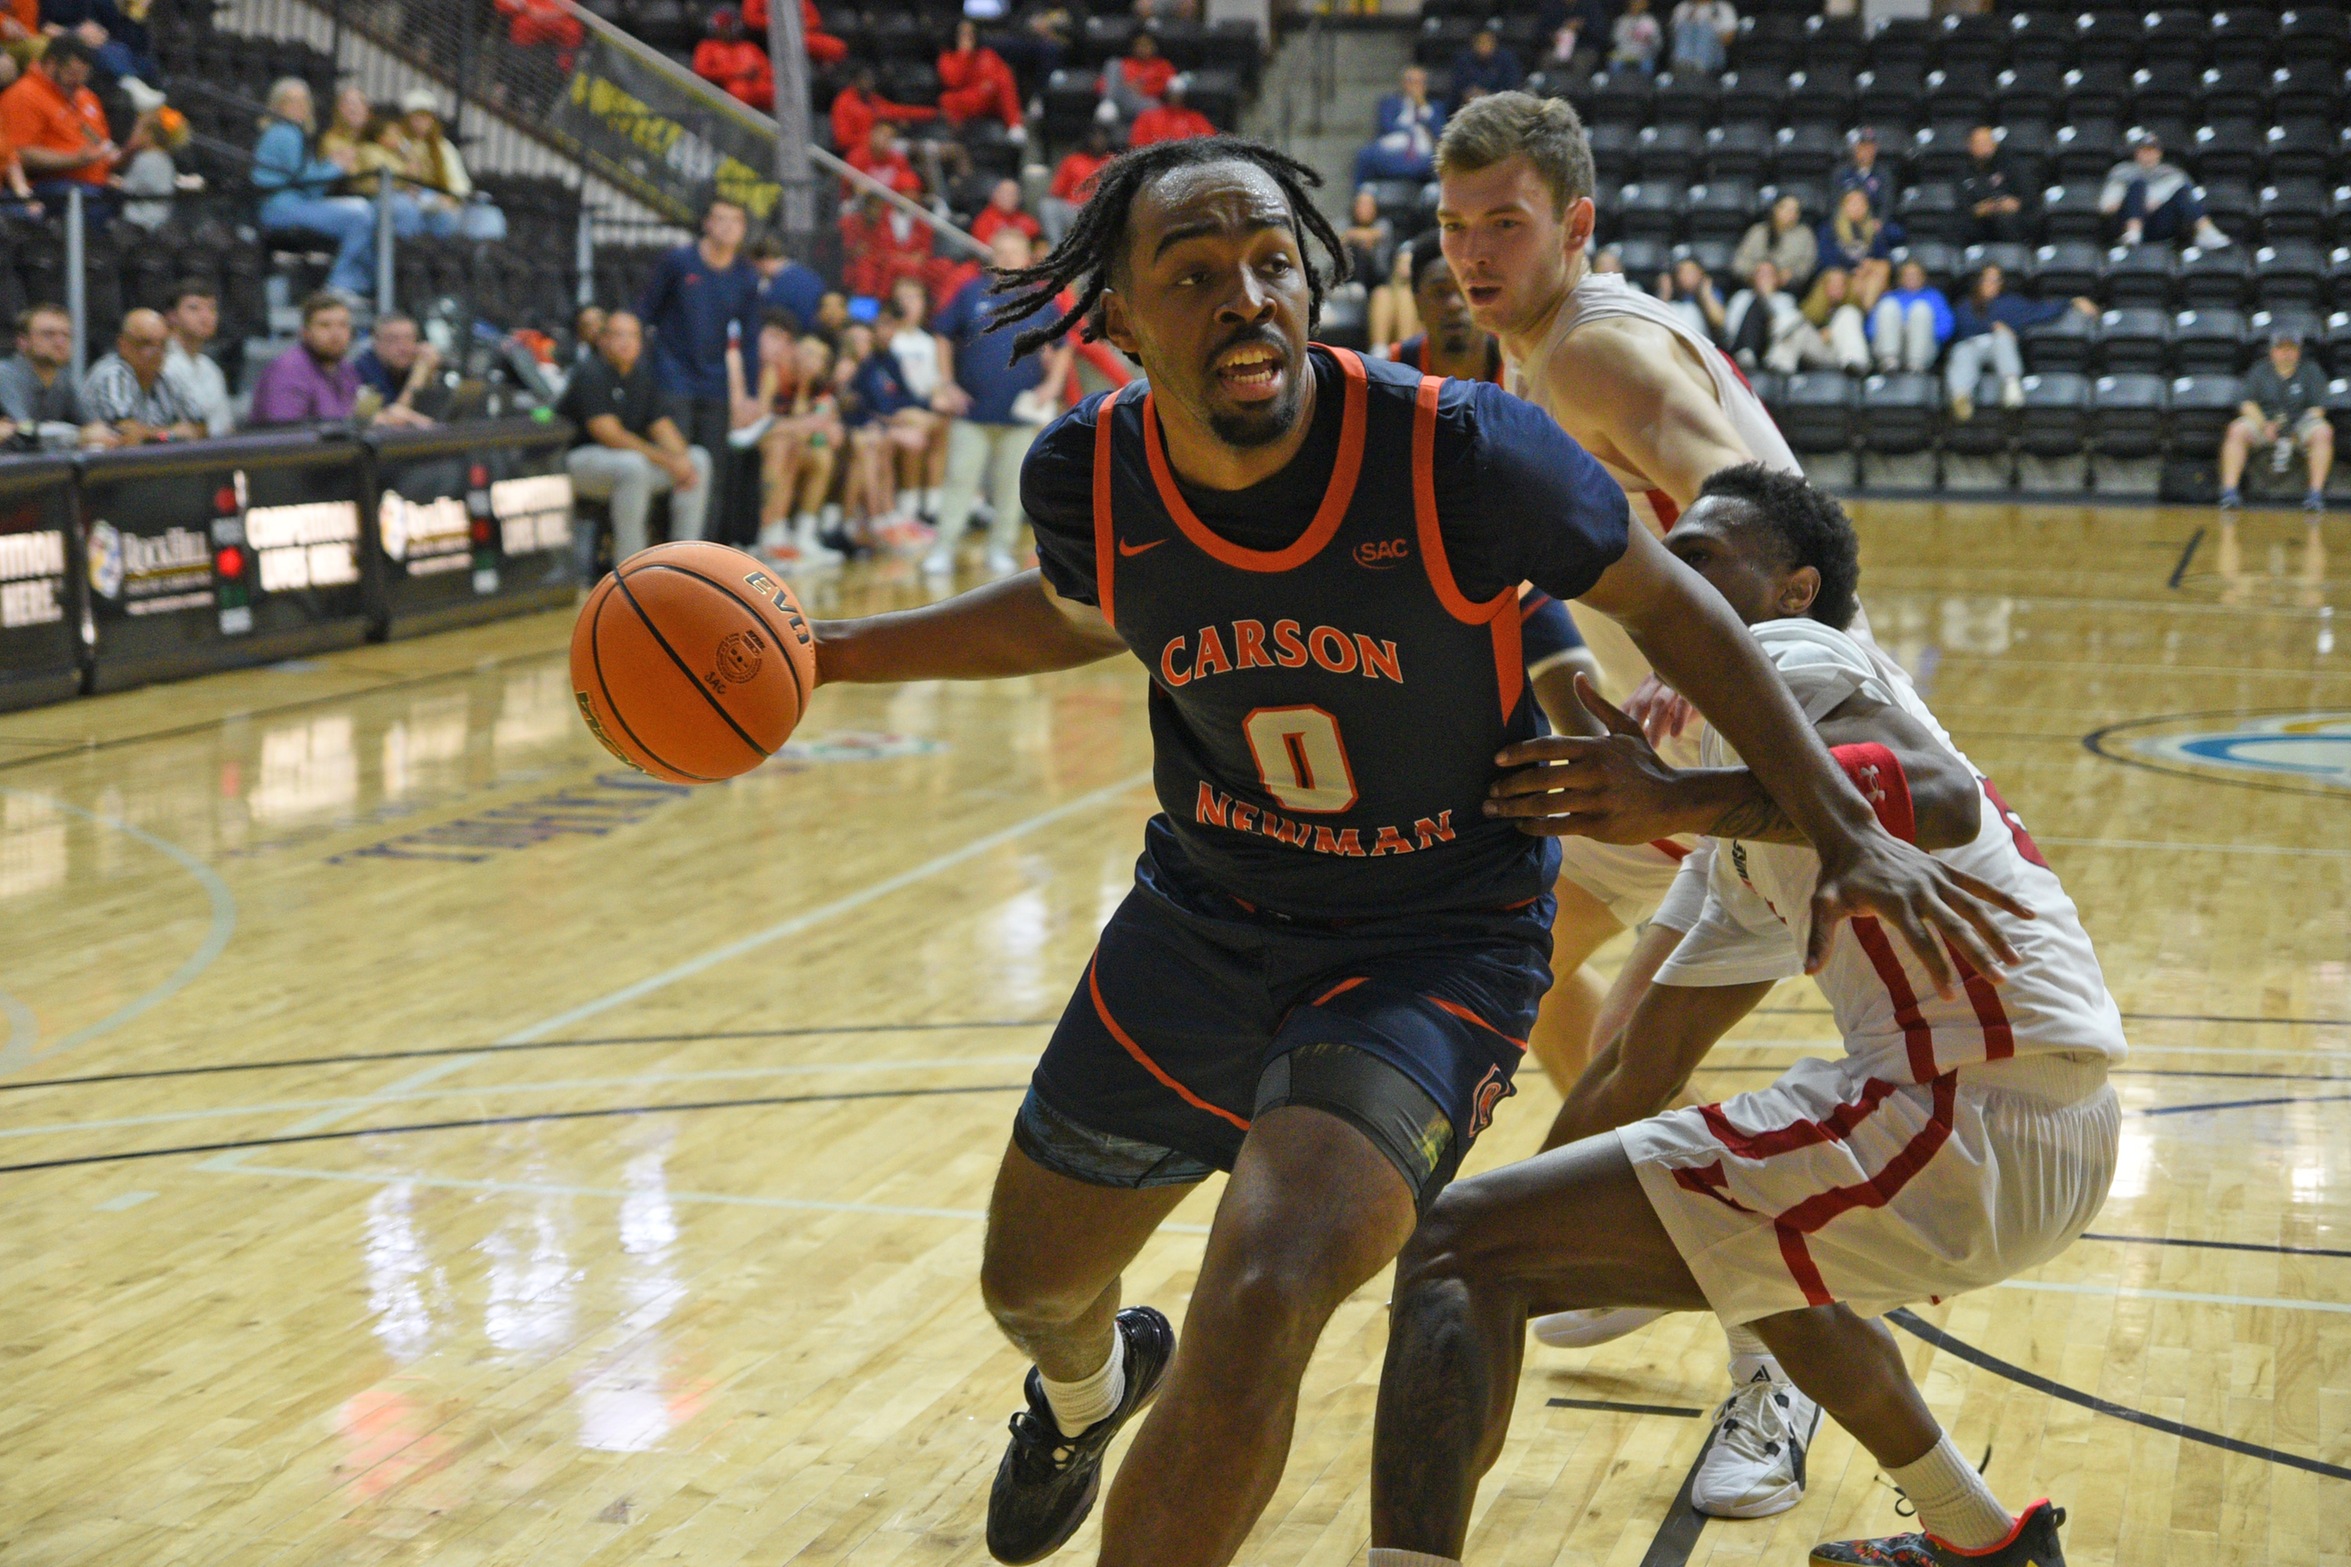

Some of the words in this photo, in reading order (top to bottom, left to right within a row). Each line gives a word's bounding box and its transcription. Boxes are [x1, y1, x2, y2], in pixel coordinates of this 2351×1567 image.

[1361, 538, 1409, 561] SAC
[1161, 618, 1404, 687] CARSON
[1242, 703, 1359, 814] 0
[1196, 780, 1457, 857] NEWMAN
